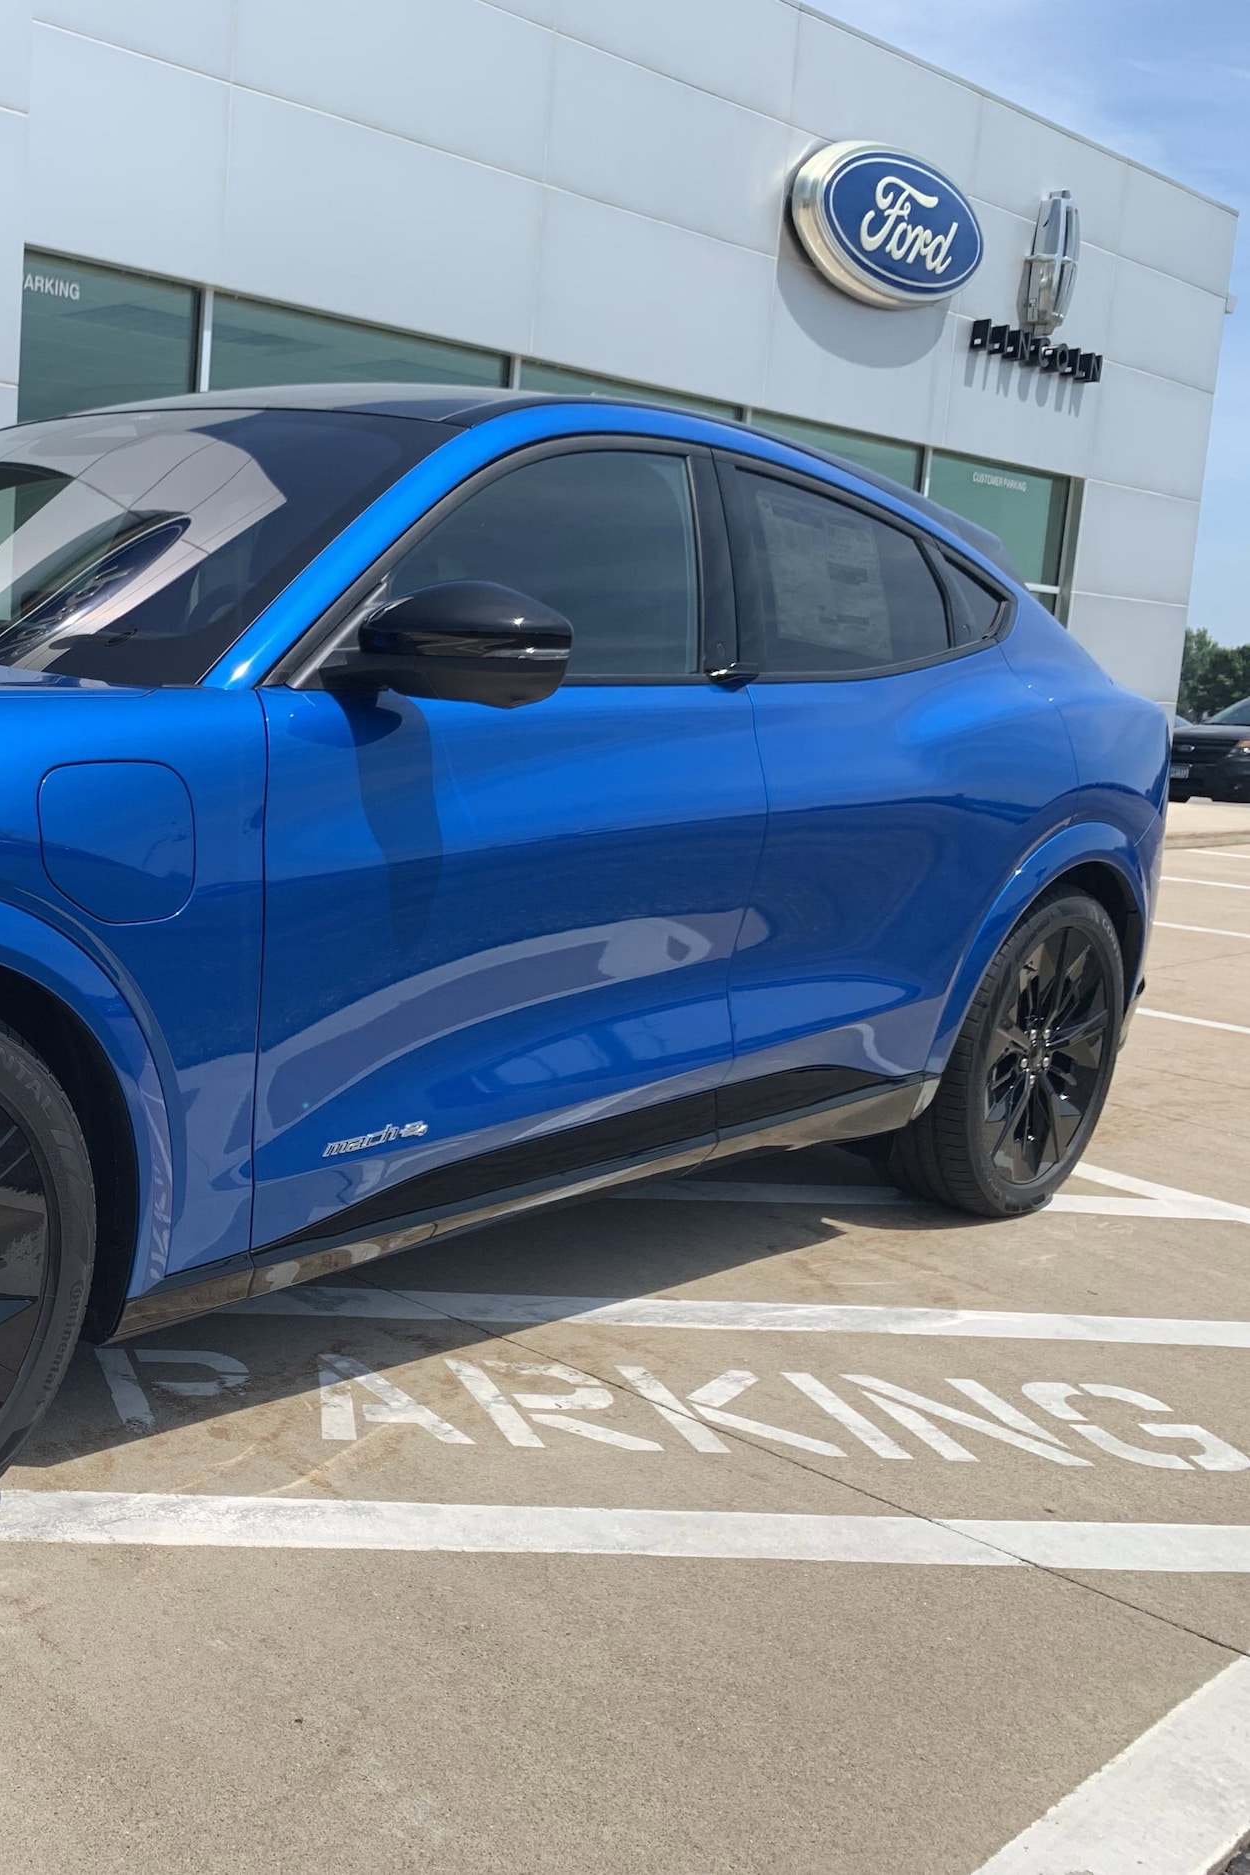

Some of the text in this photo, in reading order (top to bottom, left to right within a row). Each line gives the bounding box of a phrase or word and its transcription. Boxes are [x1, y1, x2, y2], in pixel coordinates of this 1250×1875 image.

[860, 176, 958, 274] Ford
[24, 273, 80, 300] ARKING
[973, 471, 1027, 492] CUSTOMER PARKING
[93, 1348, 1250, 1472] PARKING
